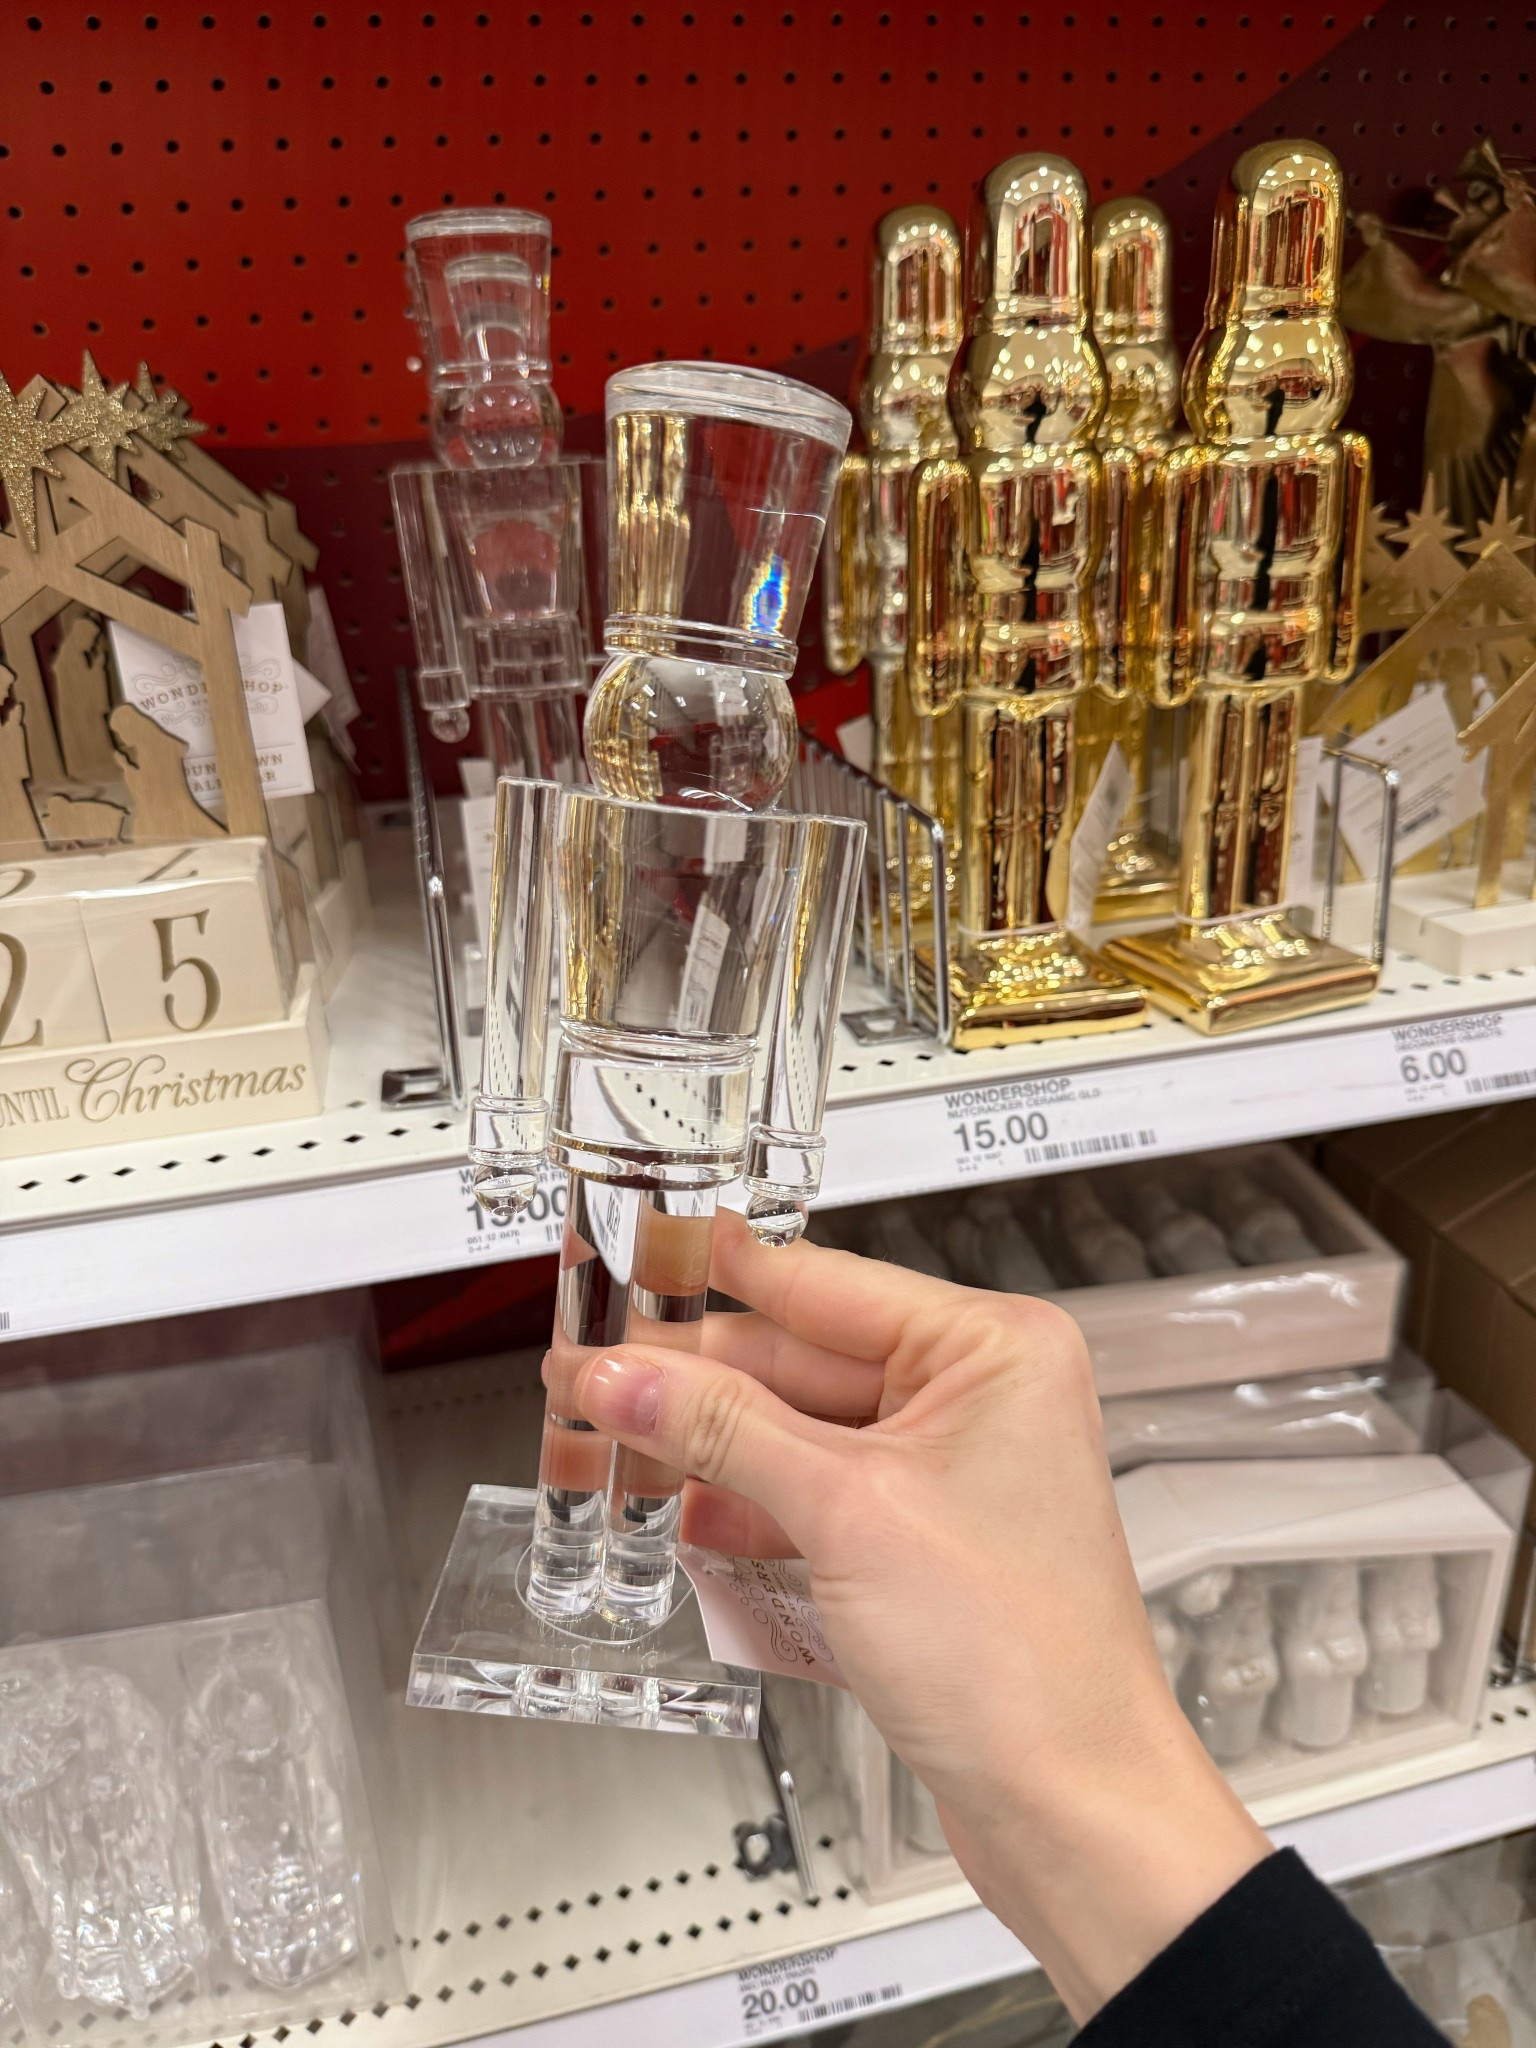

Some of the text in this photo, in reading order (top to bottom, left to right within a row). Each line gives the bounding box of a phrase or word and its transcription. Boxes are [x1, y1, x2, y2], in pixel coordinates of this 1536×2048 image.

[152, 908, 222, 1033] 5
[1391, 1013, 1503, 1042] WONDERSHOP
[1400, 1049, 1466, 1083] 6.00
[65, 1053, 307, 1123] Christmas
[945, 1077, 1071, 1109] WONDERSHOP
[947, 1101, 1023, 1119] NUTCRACKER
[953, 1111, 1049, 1153] 15.00
[742, 1978, 819, 2020] 20.00
